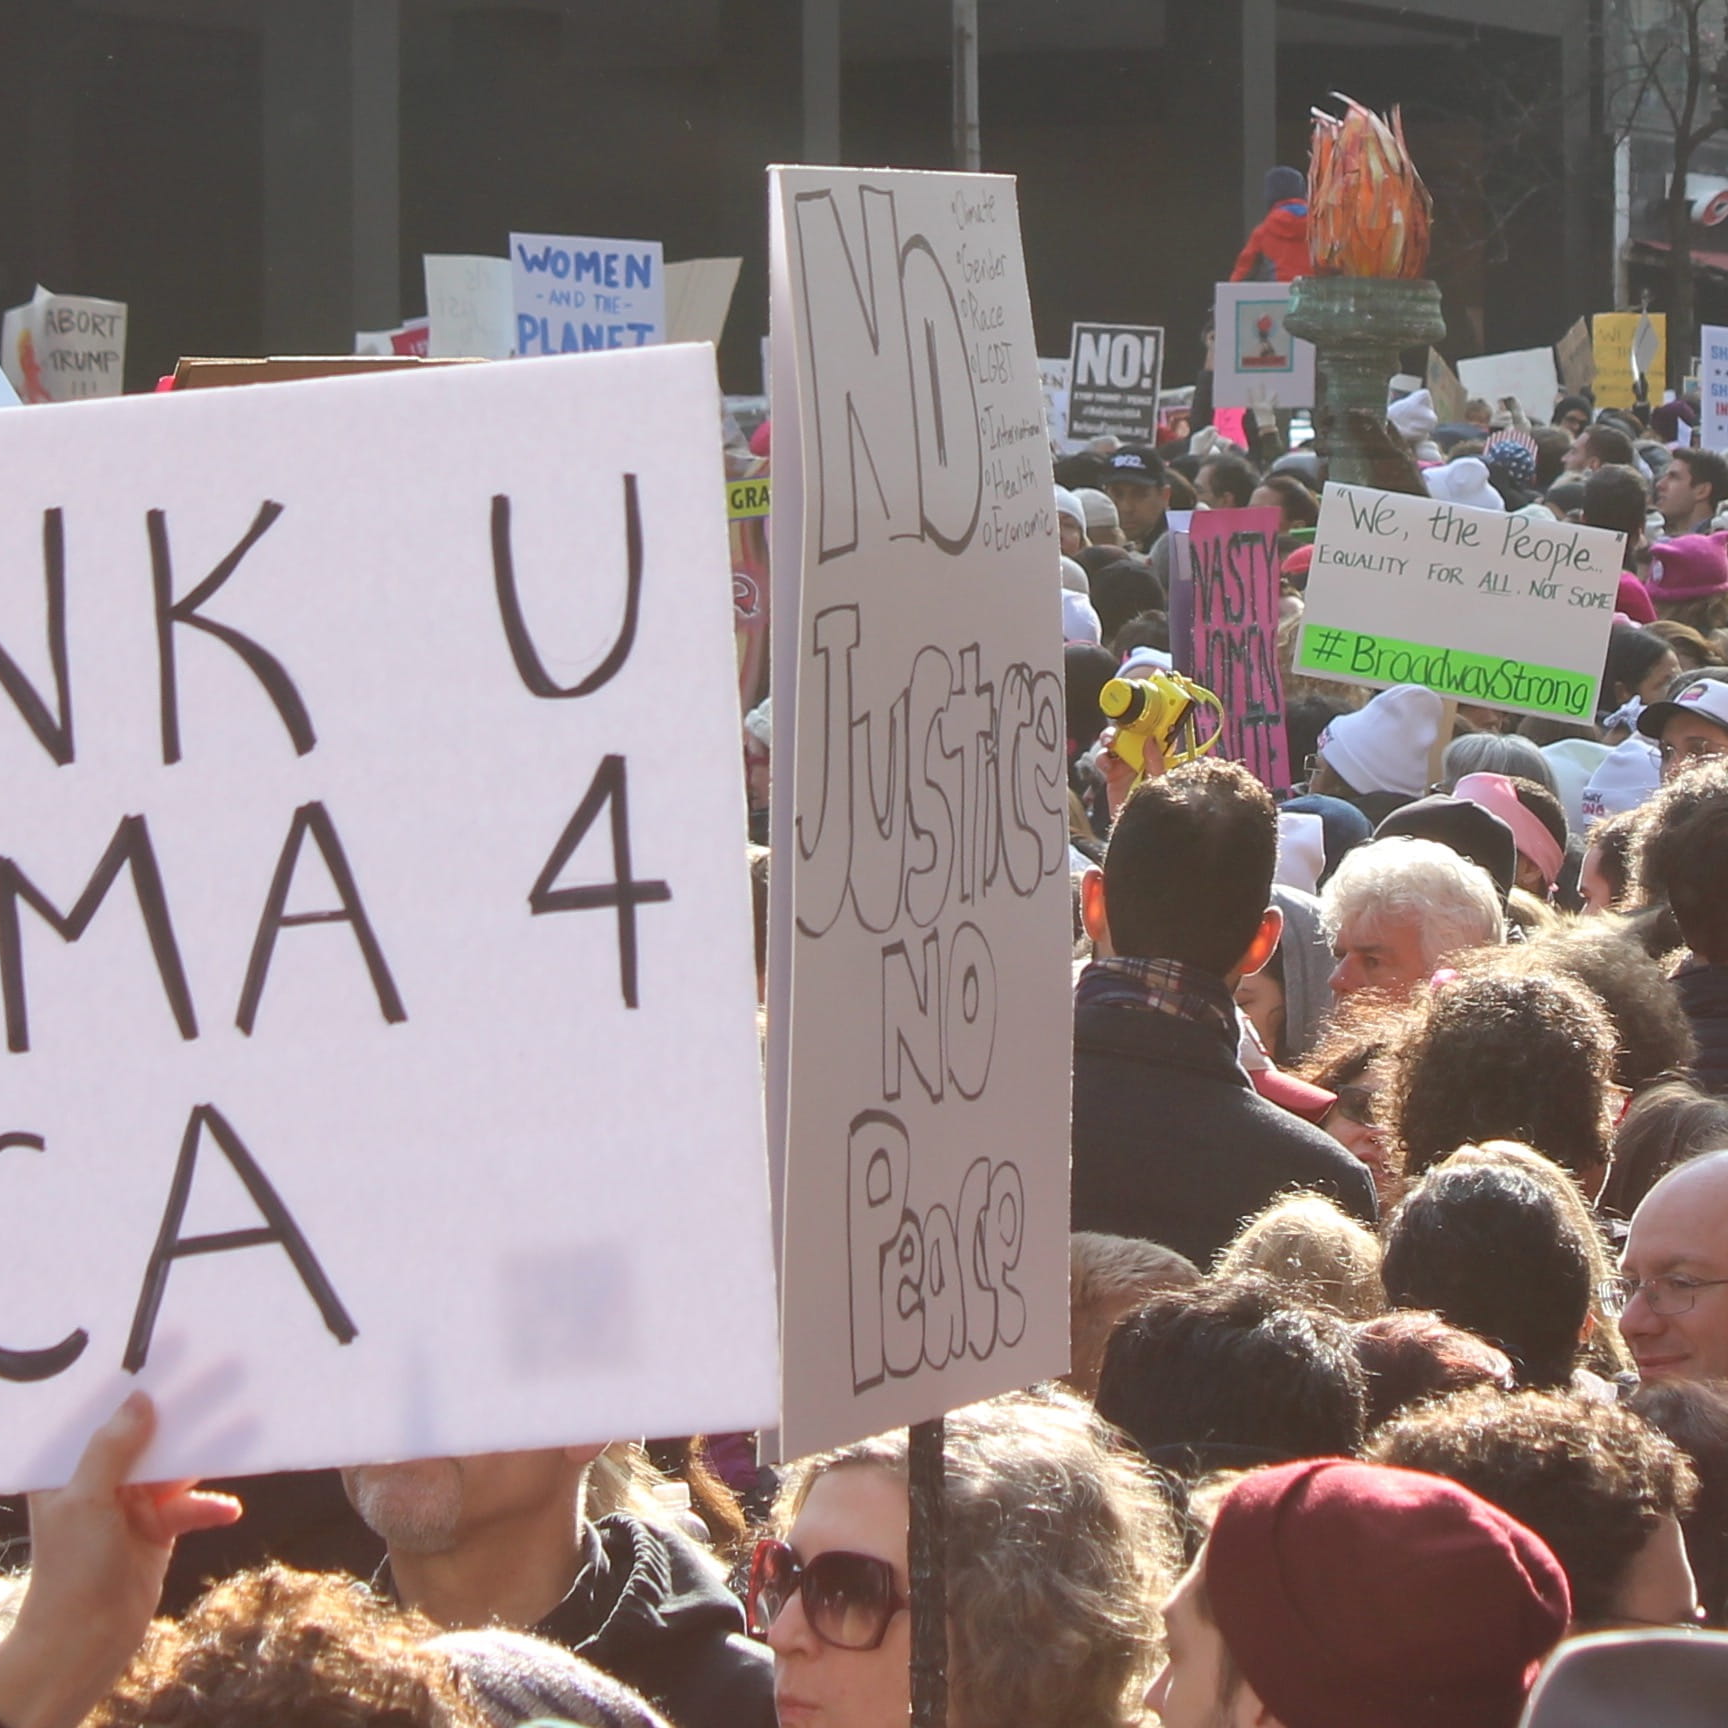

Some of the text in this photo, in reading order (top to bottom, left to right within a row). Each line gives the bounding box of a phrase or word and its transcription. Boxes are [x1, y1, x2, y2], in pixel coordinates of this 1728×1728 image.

[517, 243, 652, 290] WOMEN
[960, 243, 1007, 284] Gender
[45, 309, 122, 339] ABORT
[549, 289, 585, 310] AND
[594, 293, 621, 314] THE
[969, 290, 1005, 332] Race
[517, 313, 654, 356] PLANET
[49, 351, 120, 371] TRUMP
[795, 184, 983, 566] NO
[976, 341, 1012, 384] LGBT
[1076, 332, 1157, 389] NO!
[731, 484, 770, 511] GRA
[992, 456, 1037, 502] Health
[992, 505, 1054, 552] Economic
[1429, 506, 1481, 548] the
[491, 472, 645, 699] U
[1190, 531, 1279, 625] NASTY
[1318, 544, 1410, 576] EQUALITY
[1428, 563, 1464, 585] FOR
[1529, 579, 1563, 601] NOT
[1568, 586, 1614, 610] SOME
[1312, 629, 1590, 715] #BroadwayStrong
[529, 755, 672, 1009] 4
[881, 920, 997, 1102] NO
[846, 1108, 1027, 1395] Peace
